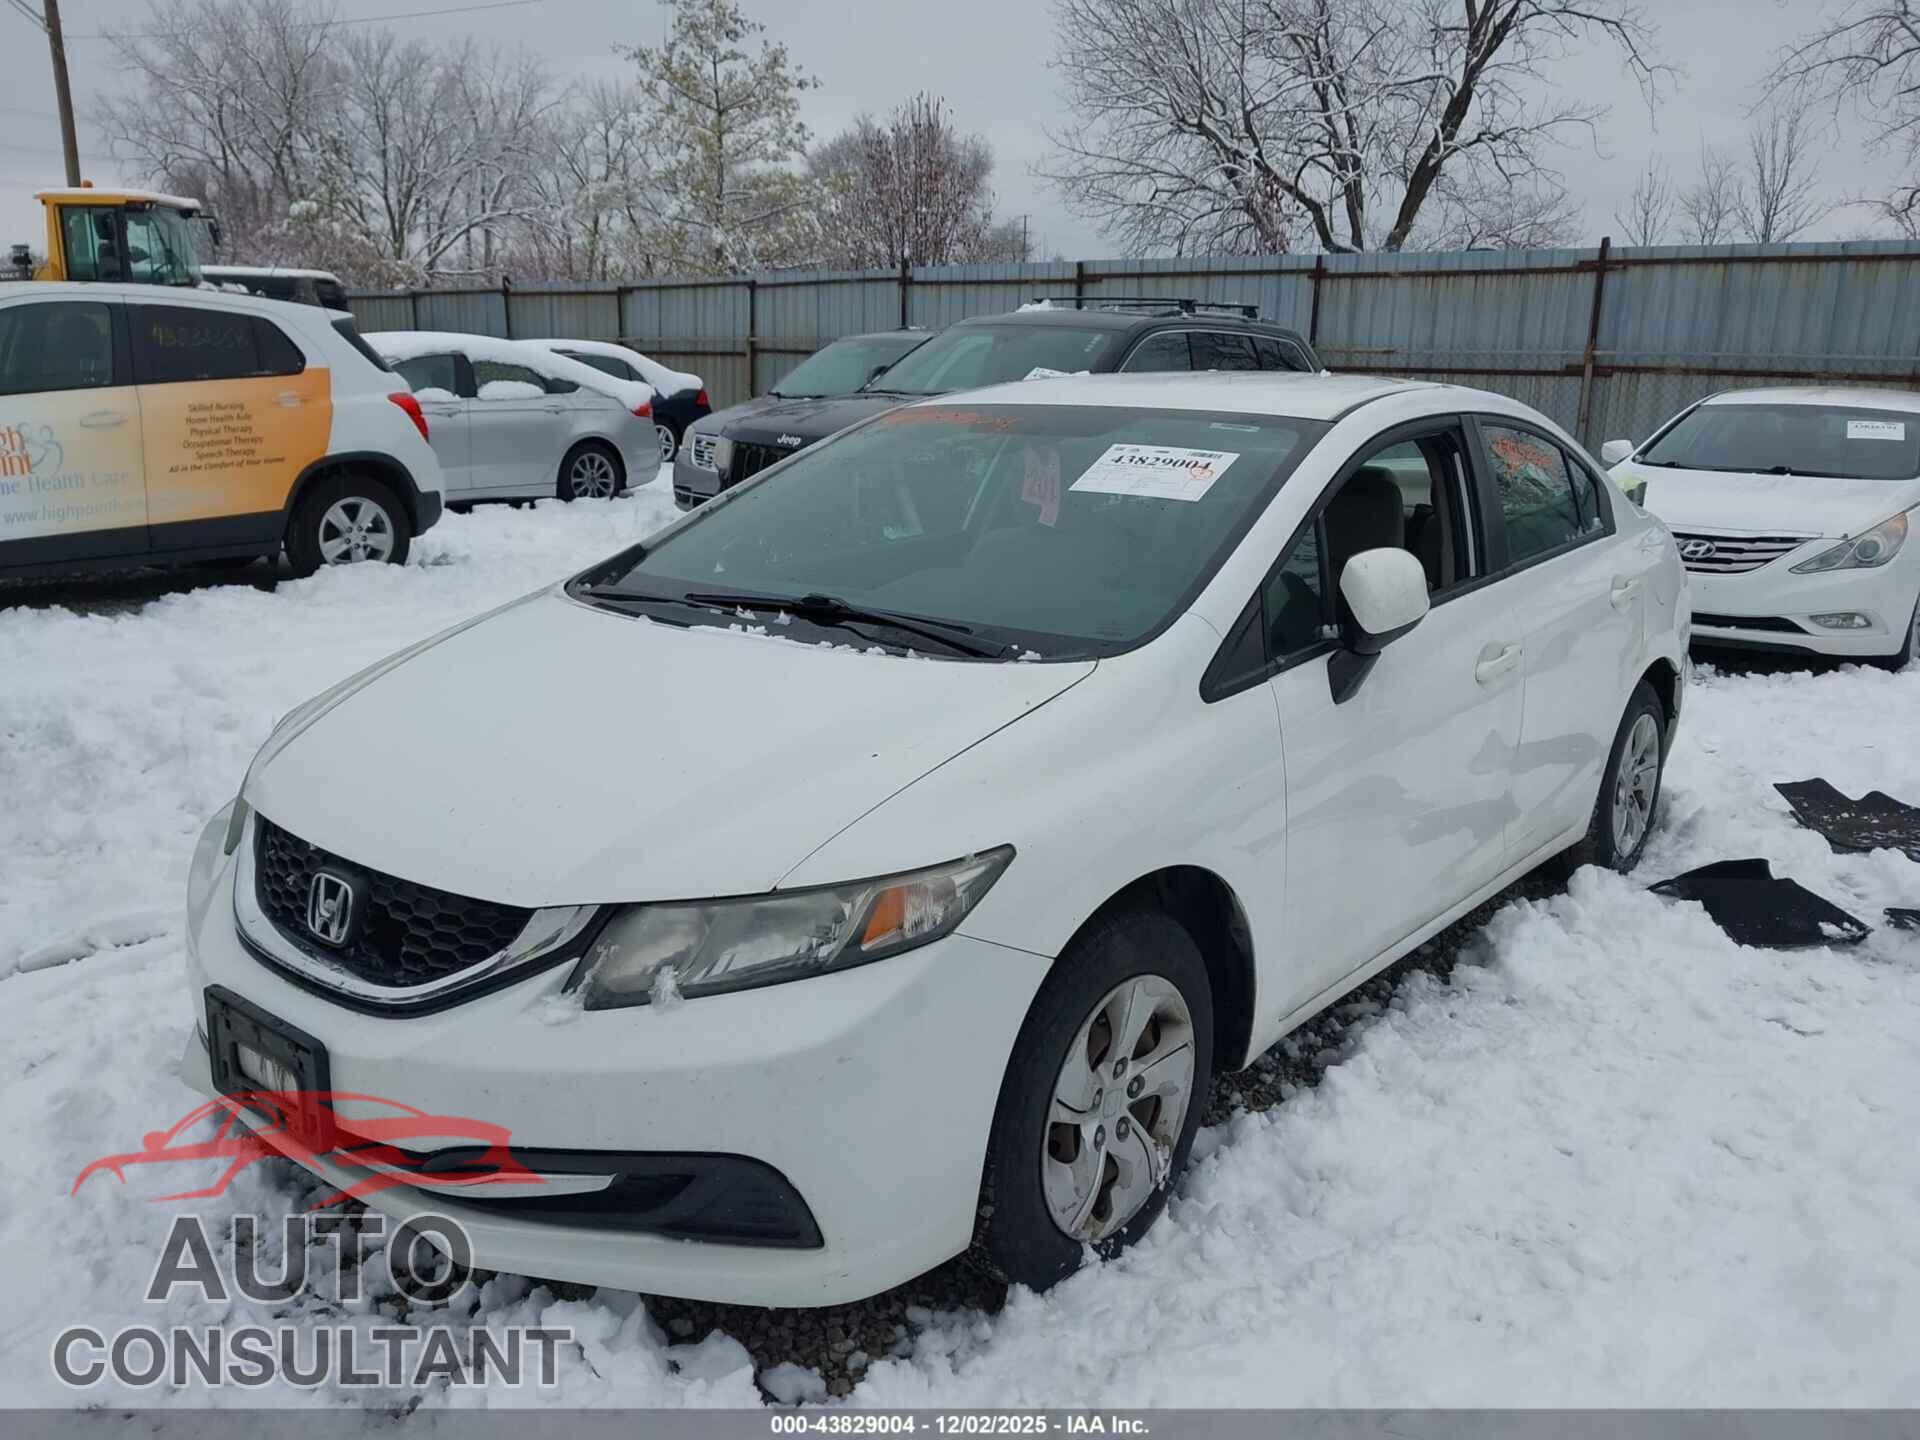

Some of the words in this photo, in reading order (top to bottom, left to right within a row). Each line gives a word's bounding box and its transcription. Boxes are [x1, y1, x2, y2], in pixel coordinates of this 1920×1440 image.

[185, 415, 207, 424] Home
[209, 413, 234, 423] Health
[190, 426, 221, 437] Physical
[223, 425, 253, 435] Therapy
[182, 438, 232, 449] Occupational
[234, 435, 264, 445] Therapy
[777, 433, 801, 447] Jeep
[195, 449, 223, 460] Speech
[225, 447, 256, 457] Therapy
[190, 463, 202, 471] the
[1111, 454, 1213, 470] 43829004
[28, 472, 86, 492] Health
